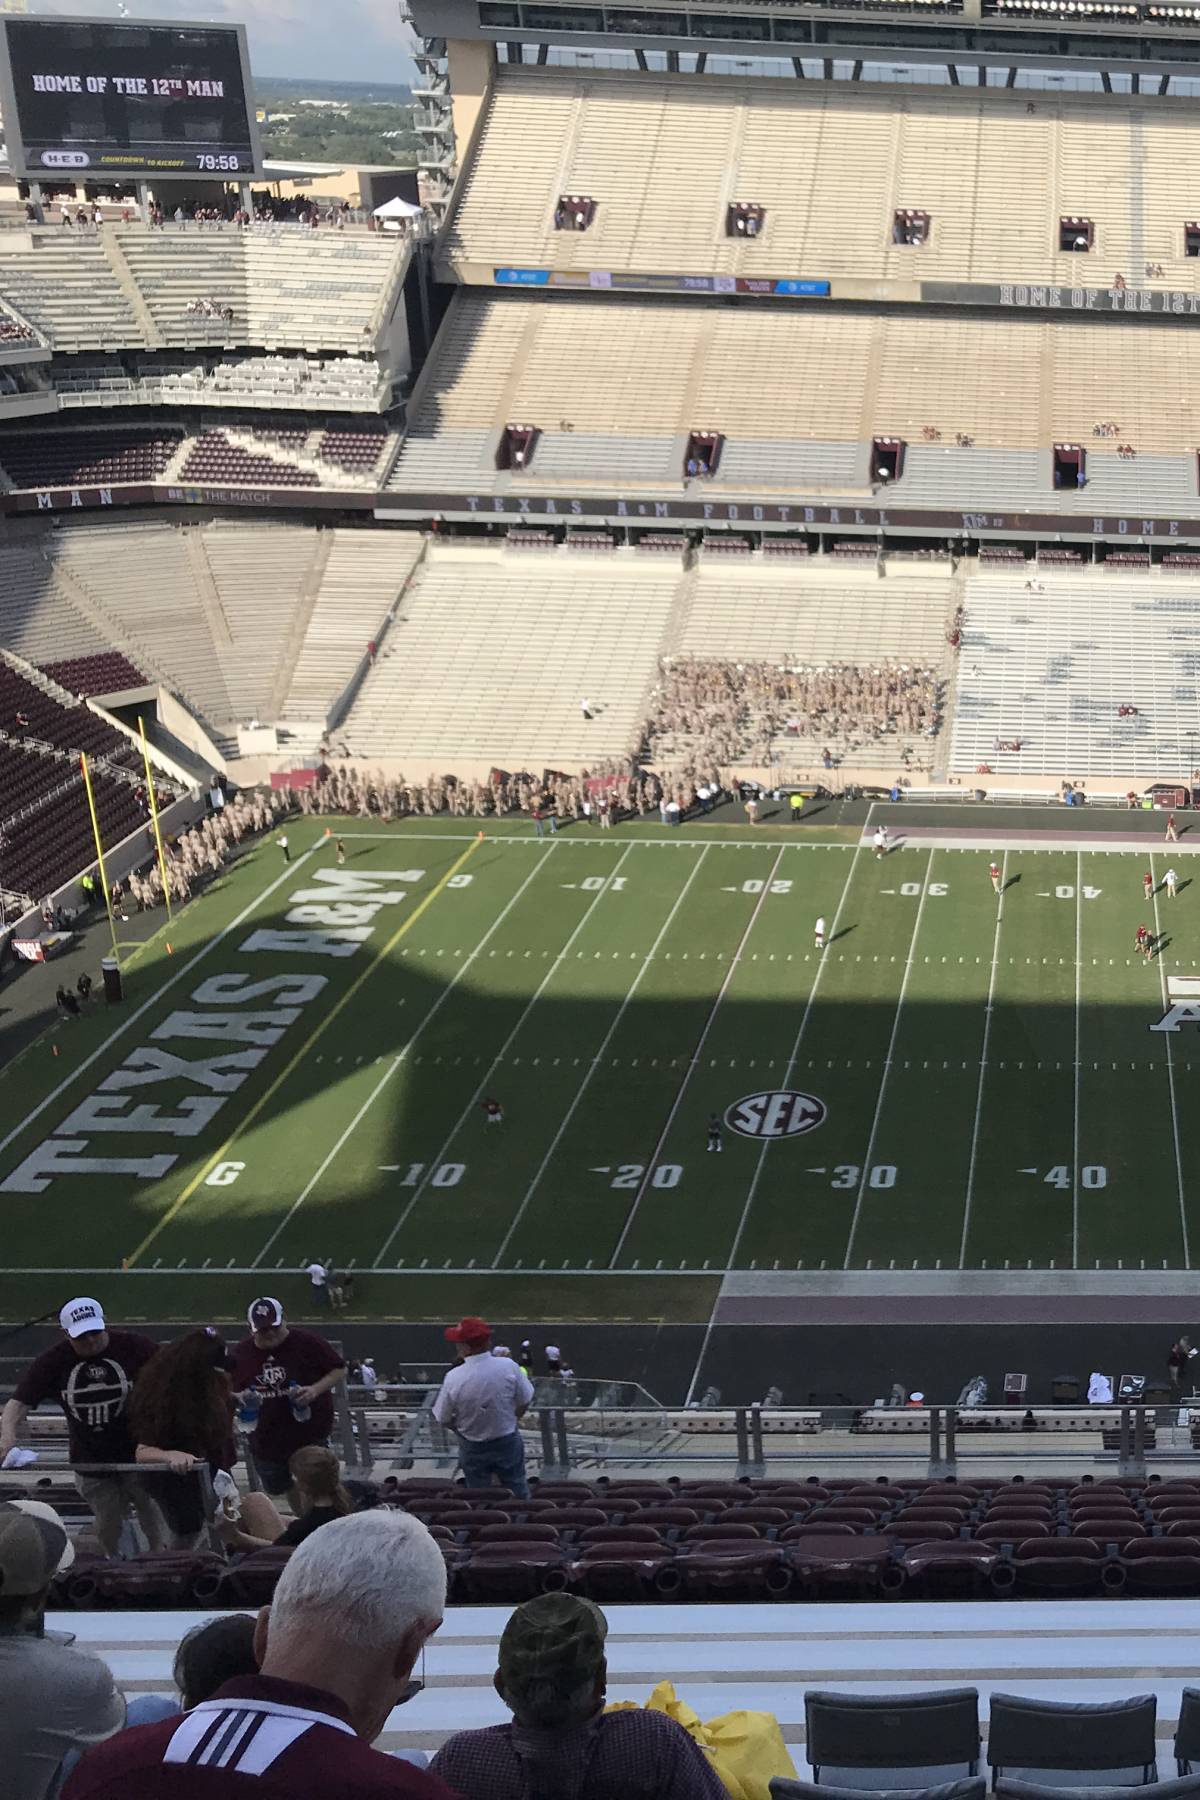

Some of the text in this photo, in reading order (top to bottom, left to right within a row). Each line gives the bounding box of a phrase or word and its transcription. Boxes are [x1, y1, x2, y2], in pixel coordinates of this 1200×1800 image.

[32, 74, 82, 92] HOME
[86, 76, 108, 93] OF
[112, 77, 148, 95] THE
[186, 80, 224, 98] MAN
[100, 155, 145, 165] COUNTDOWN
[196, 154, 239, 170] 79:58
[1000, 285, 1061, 306] HOME
[1071, 289, 1098, 309] OF
[1109, 290, 1151, 311] THE
[36, 489, 113, 509] MAN
[169, 489, 271, 503] BE THE MATCH
[467, 496, 582, 514] TEXAS
[704, 505, 889, 524] FOOTBALL
[1094, 518, 1178, 536] HOME
[580, 877, 628, 891] 10
[741, 879, 794, 893] 20
[900, 883, 949, 897] 30
[1055, 886, 1102, 898] 40
[0, 868, 426, 1192] TEXAS A&M
[733, 1093, 821, 1136] SEC
[205, 1162, 246, 1186] G
[400, 1163, 466, 1187] 10
[610, 1164, 683, 1189] 20
[830, 1165, 898, 1190] 30
[1043, 1166, 1107, 1190] 40
